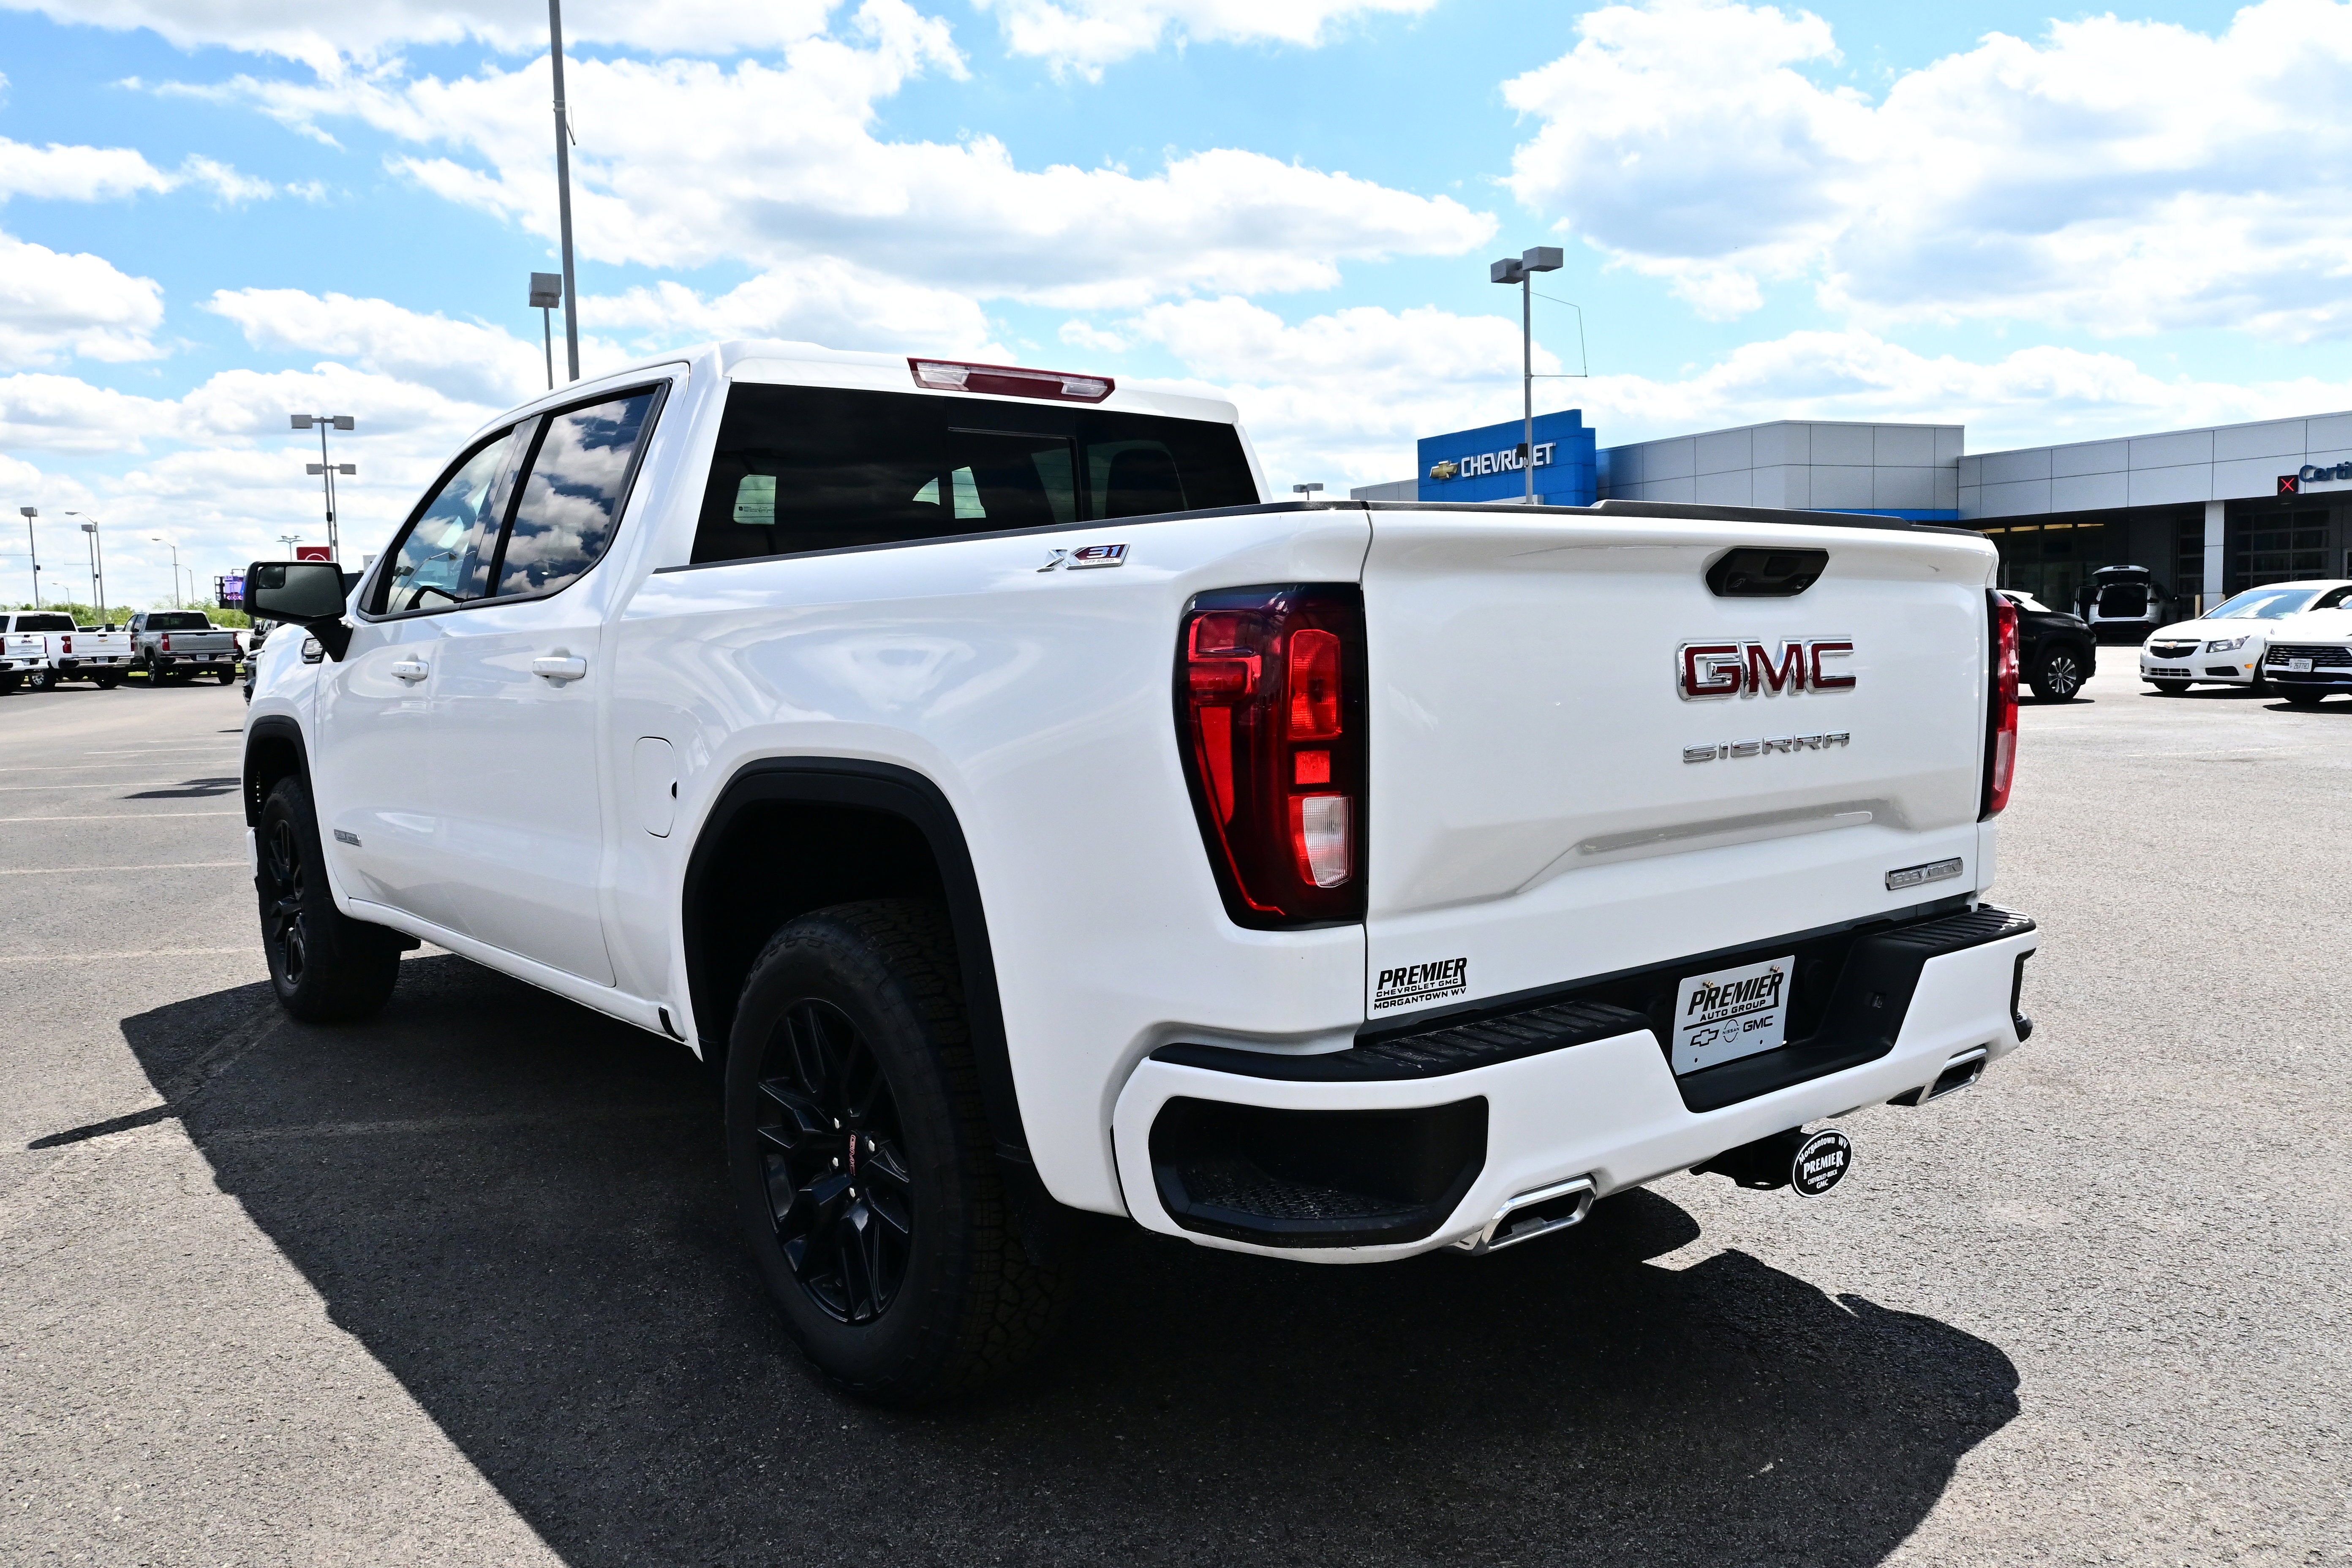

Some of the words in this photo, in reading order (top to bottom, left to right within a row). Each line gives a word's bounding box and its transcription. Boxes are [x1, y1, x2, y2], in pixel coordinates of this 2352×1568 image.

[1461, 442, 1556, 477] CHEVROET
[2299, 461, 2352, 483] Certi
[1676, 637, 1856, 701] GMC
[1683, 730, 1850, 764] SIERRA
[1376, 982, 1436, 997] CHEVROLET
[1438, 978, 1459, 987] GMC
[1377, 957, 1467, 991] PREMIER
[1374, 990, 1448, 1010] MORGANTOWN
[1451, 987, 1467, 996] WV
[1687, 972, 1784, 1015] PREMIER
[1700, 1008, 1728, 1022] AUTO
[1731, 999, 1766, 1014] GROUP
[1722, 1026, 1740, 1035] NISSAN
[1743, 1015, 1774, 1033] GMC
[1799, 1136, 1835, 1165] Morgantown
[1838, 1136, 1848, 1149] WV
[1803, 1150, 1844, 1180] PREMIER
[1816, 1179, 1829, 1189] GMC
